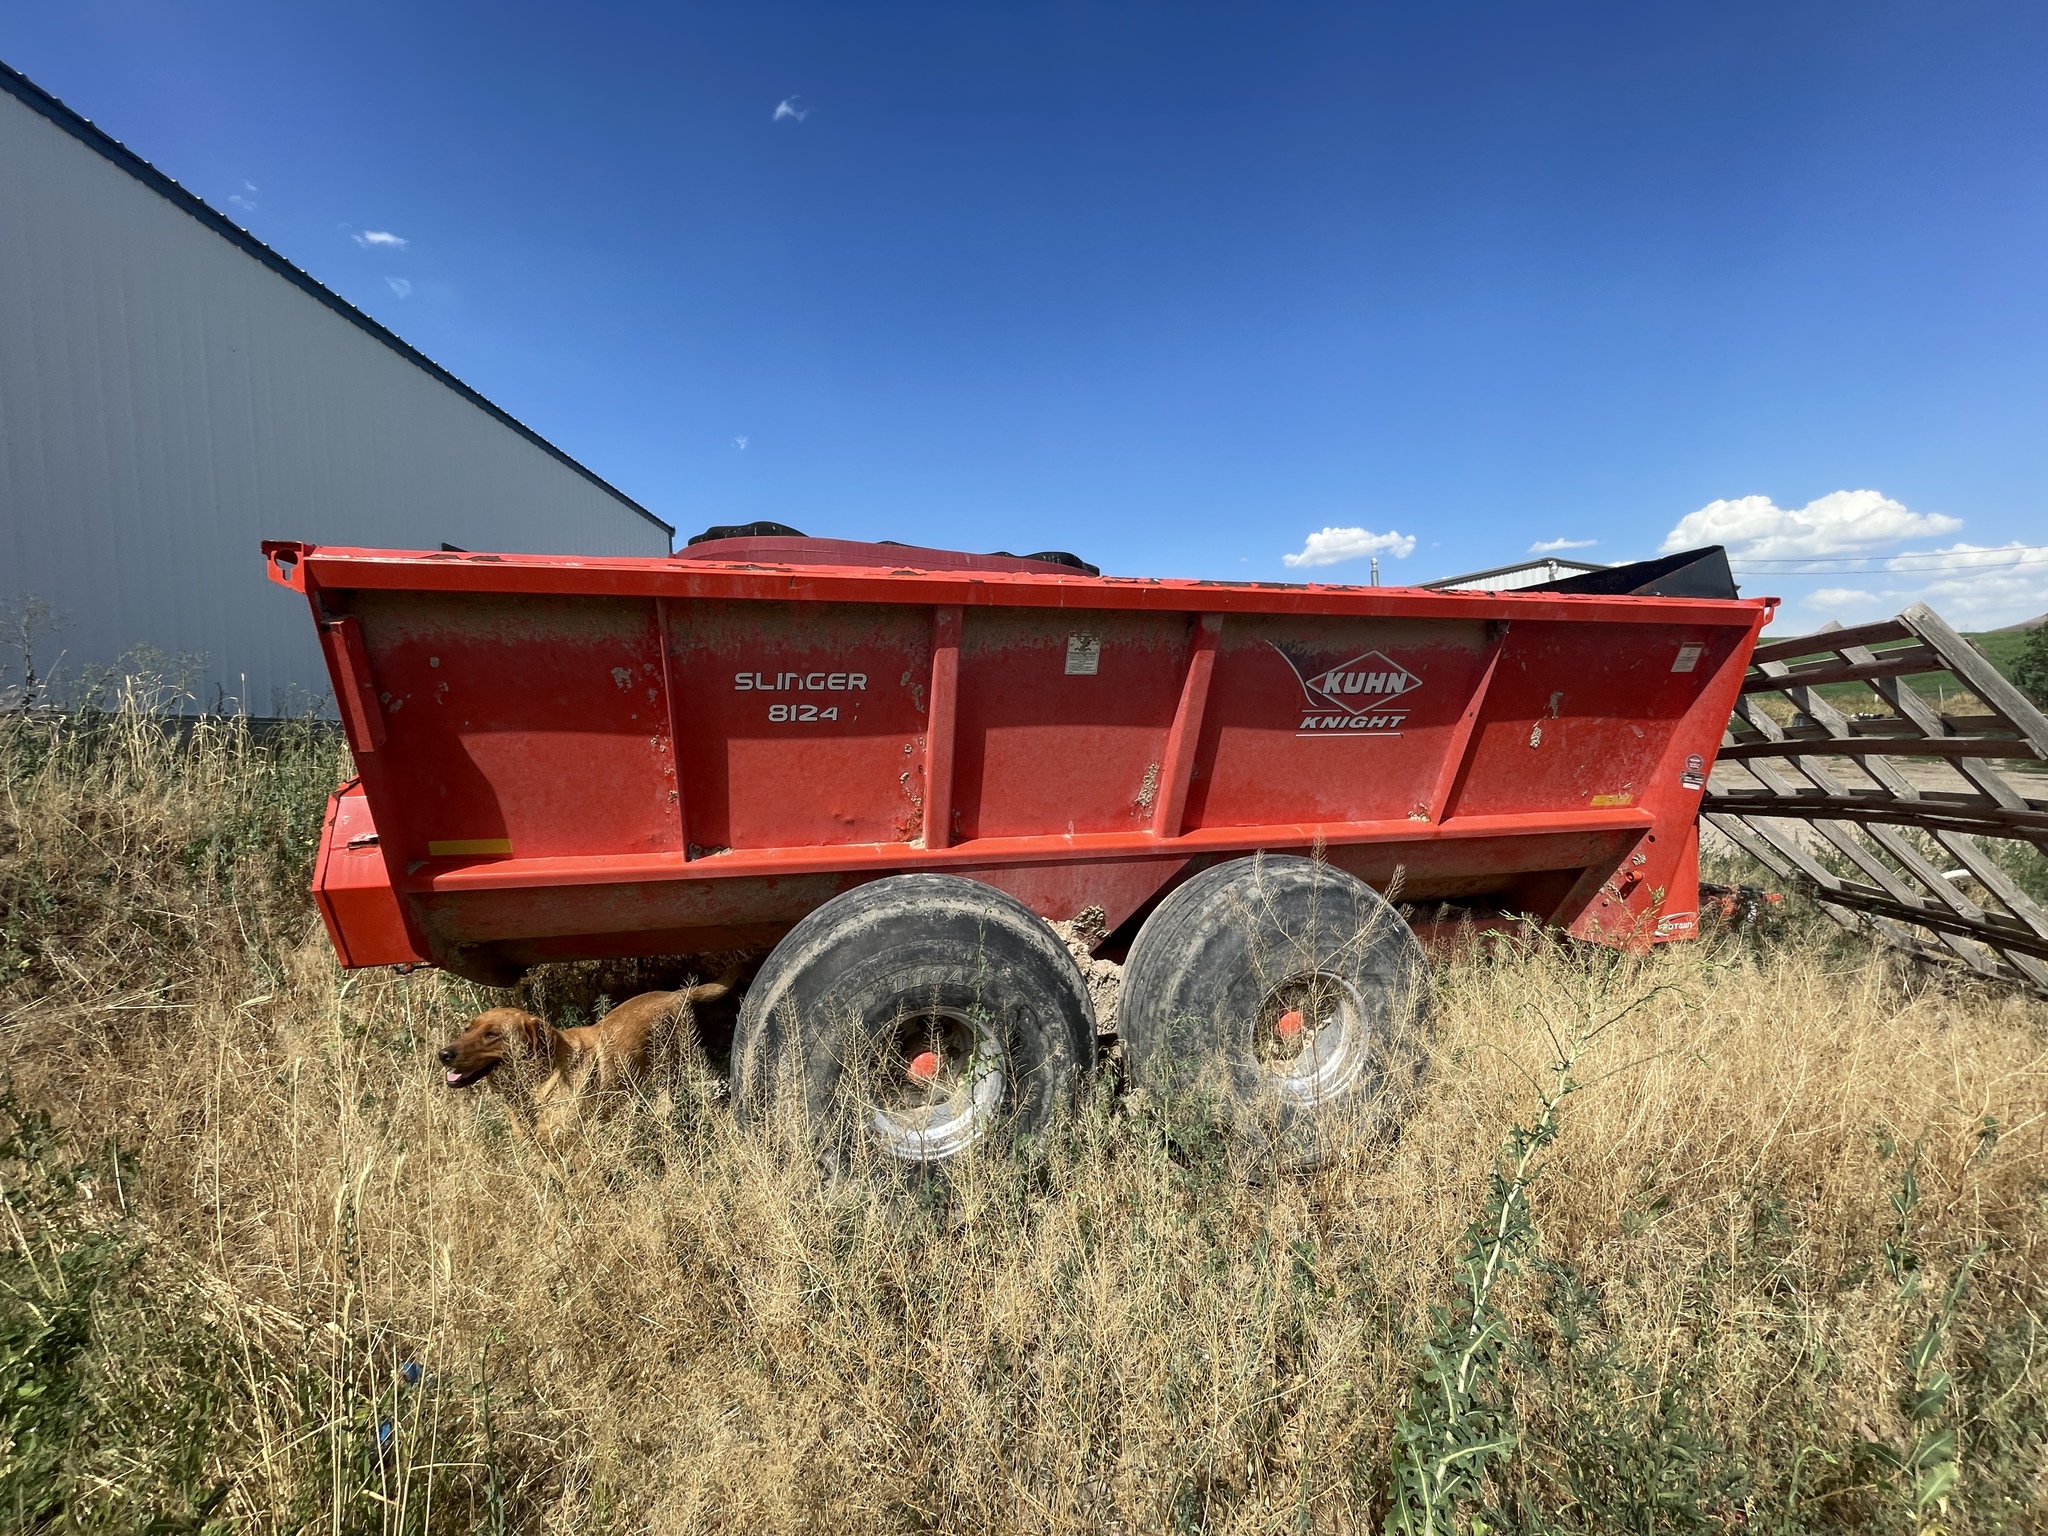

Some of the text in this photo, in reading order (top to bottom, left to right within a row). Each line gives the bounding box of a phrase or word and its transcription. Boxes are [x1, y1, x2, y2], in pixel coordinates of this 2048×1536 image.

[734, 672, 868, 691] SLINGER
[1322, 672, 1408, 694] KUHN
[768, 704, 839, 722] 8124
[1300, 715, 1406, 729] KNIGHT
